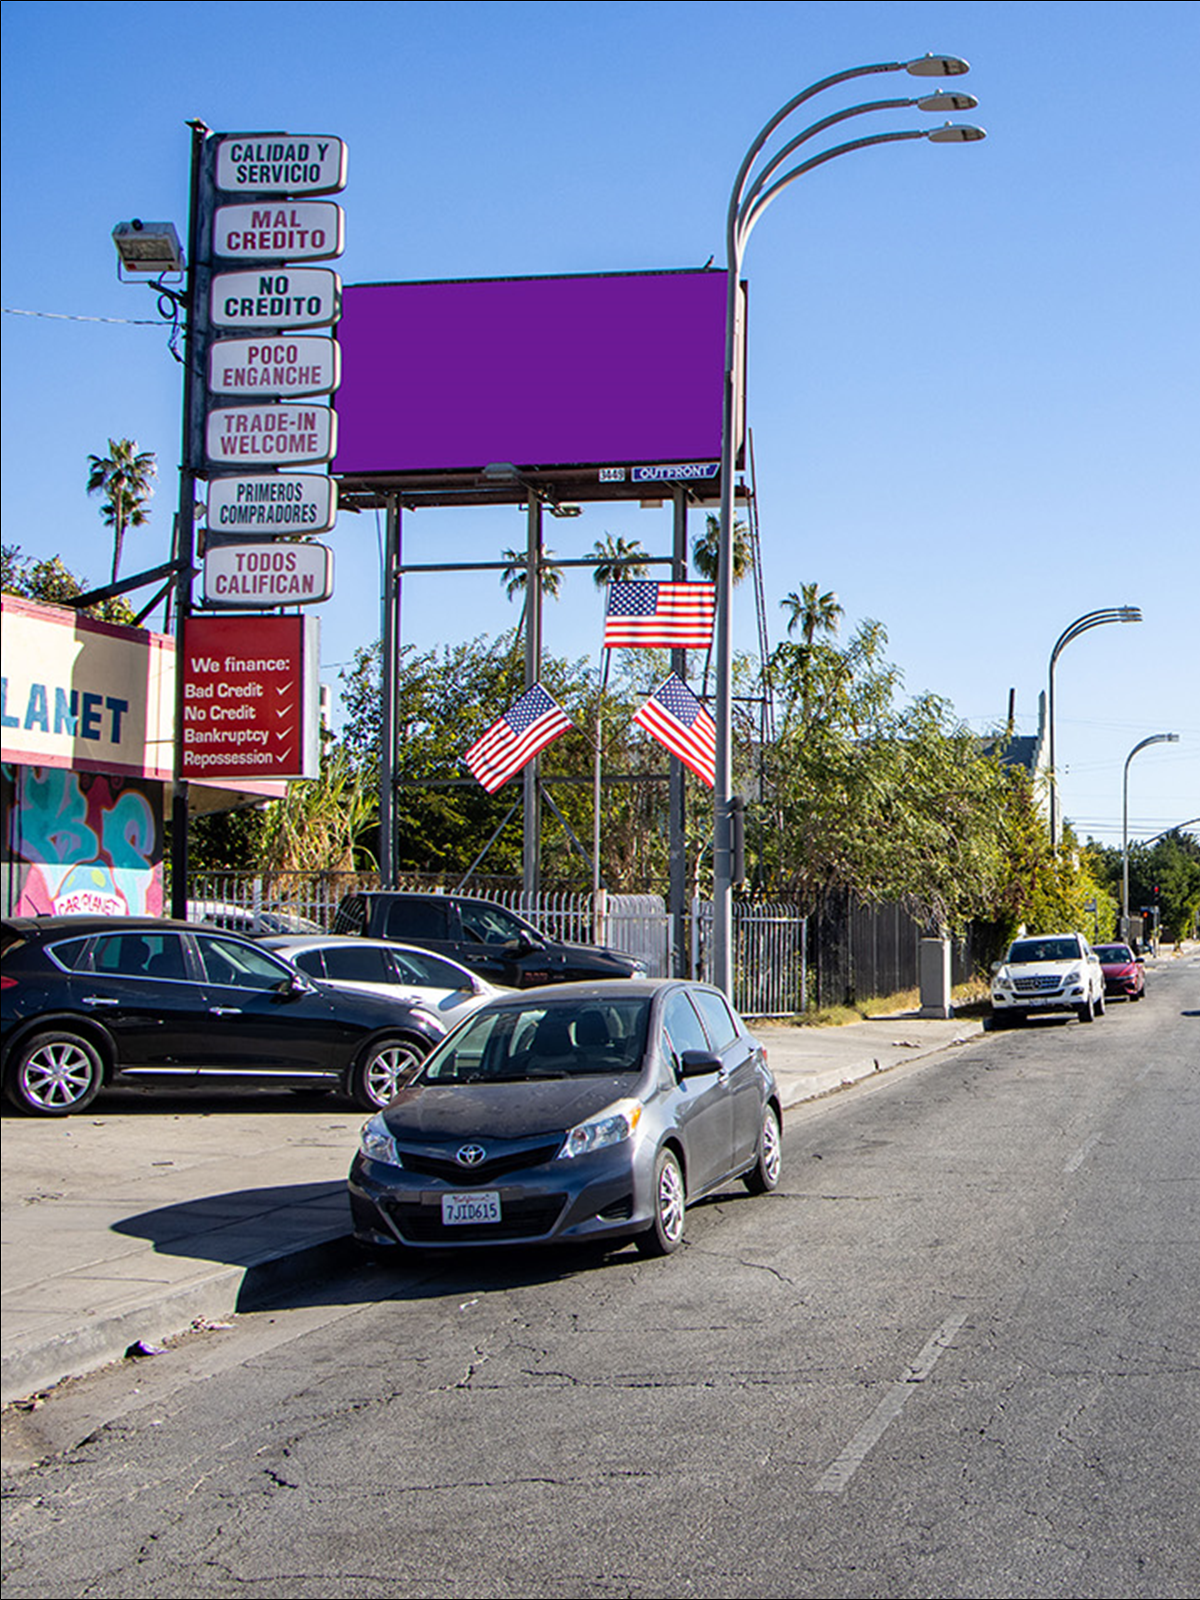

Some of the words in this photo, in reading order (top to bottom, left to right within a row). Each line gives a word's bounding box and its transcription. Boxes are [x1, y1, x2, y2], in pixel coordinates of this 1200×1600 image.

[230, 144, 309, 163] CALIDAD
[317, 144, 329, 162] Y
[236, 164, 321, 184] SERVICIO
[251, 210, 302, 228] MAL
[227, 230, 325, 250] CREDITO
[259, 276, 289, 295] NO
[224, 297, 321, 317] CREDITO
[248, 344, 298, 365] POCO
[223, 366, 321, 387] ENGANCHE
[224, 412, 316, 433] TRADE-IN
[220, 434, 318, 455] WELCOME
[640, 465, 710, 479] OUTFRONT
[236, 483, 303, 502] PRIMEROS
[219, 504, 317, 525] COMPRADORES
[235, 552, 296, 572] TODOS
[215, 574, 314, 595] CALIFICAN
[191, 657, 220, 673] We
[224, 656, 290, 672] finance:
[184, 683, 214, 698] Bad
[217, 682, 263, 698] Credit
[184, 705, 206, 720] No
[210, 704, 256, 720] Credit
[184, 728, 269, 746] Bankruptcy
[184, 749, 273, 769] Repossession
[447, 1203, 497, 1219] 7JID615
